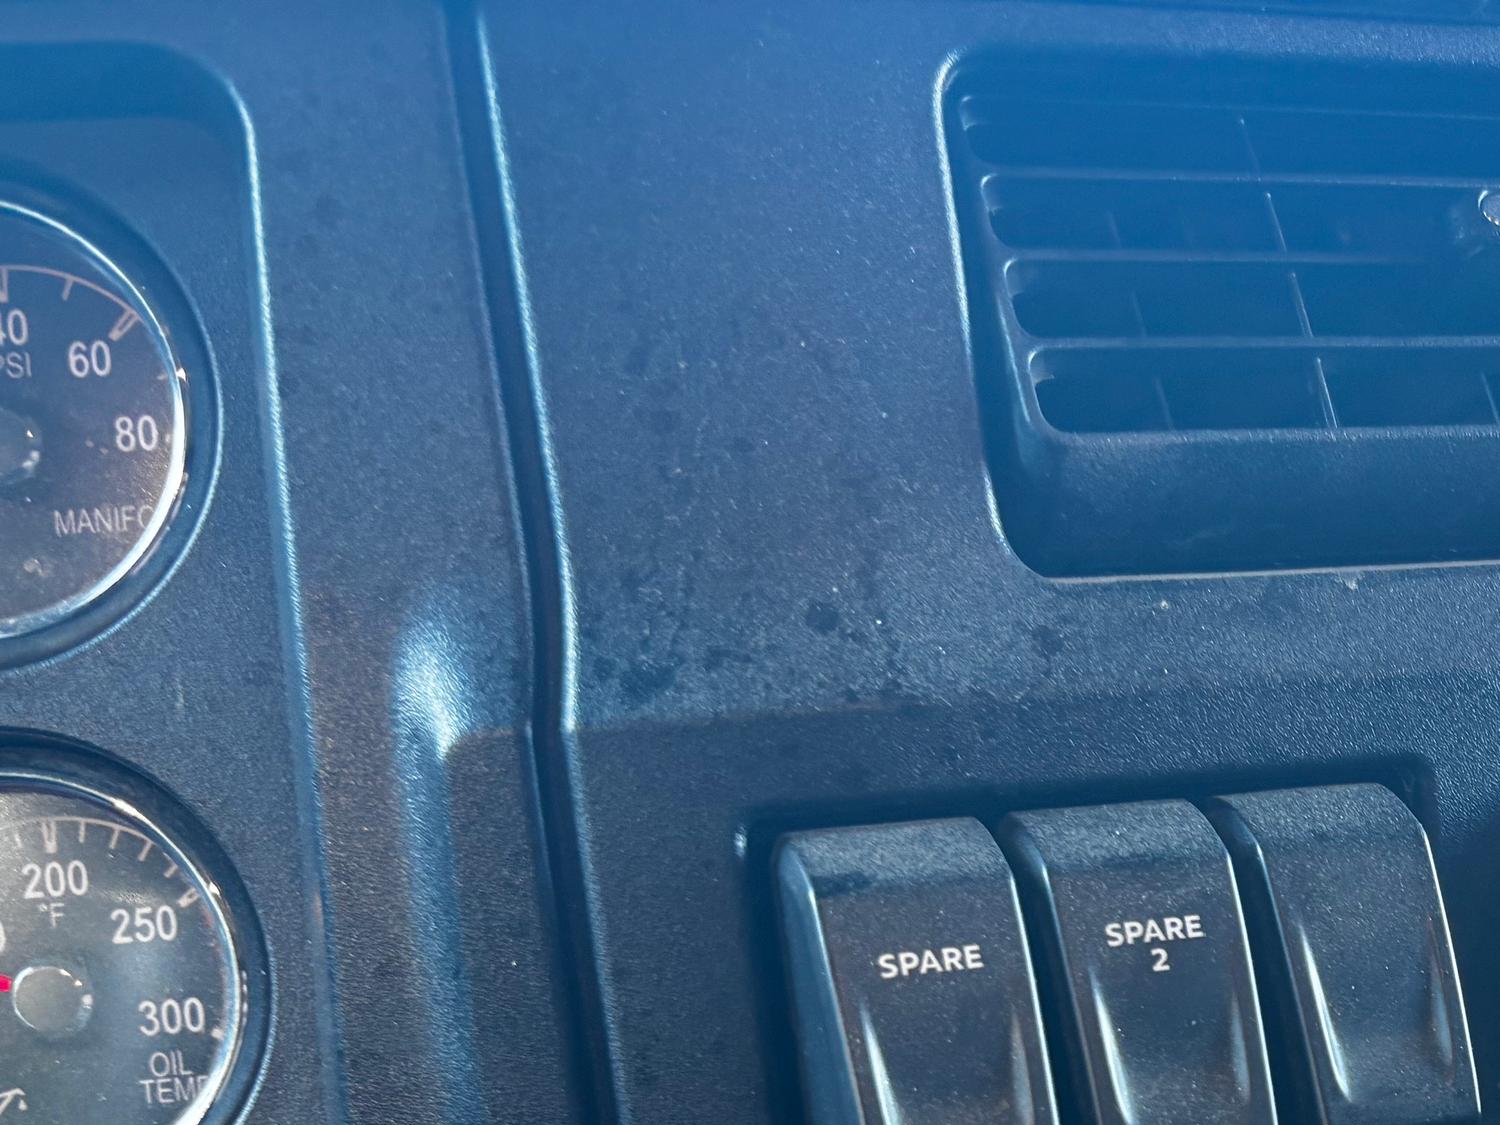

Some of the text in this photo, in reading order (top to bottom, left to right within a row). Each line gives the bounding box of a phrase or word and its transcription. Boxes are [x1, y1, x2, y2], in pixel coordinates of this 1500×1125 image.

[67, 340, 112, 378] 60
[115, 415, 159, 452] 80
[21, 860, 89, 899] 200
[110, 904, 178, 944] 250
[1105, 914, 1204, 947] SPARE
[877, 944, 984, 979] SPARE
[1151, 948, 1170, 972] 2
[138, 997, 206, 1036] 300
[149, 1049, 193, 1077] OIL
